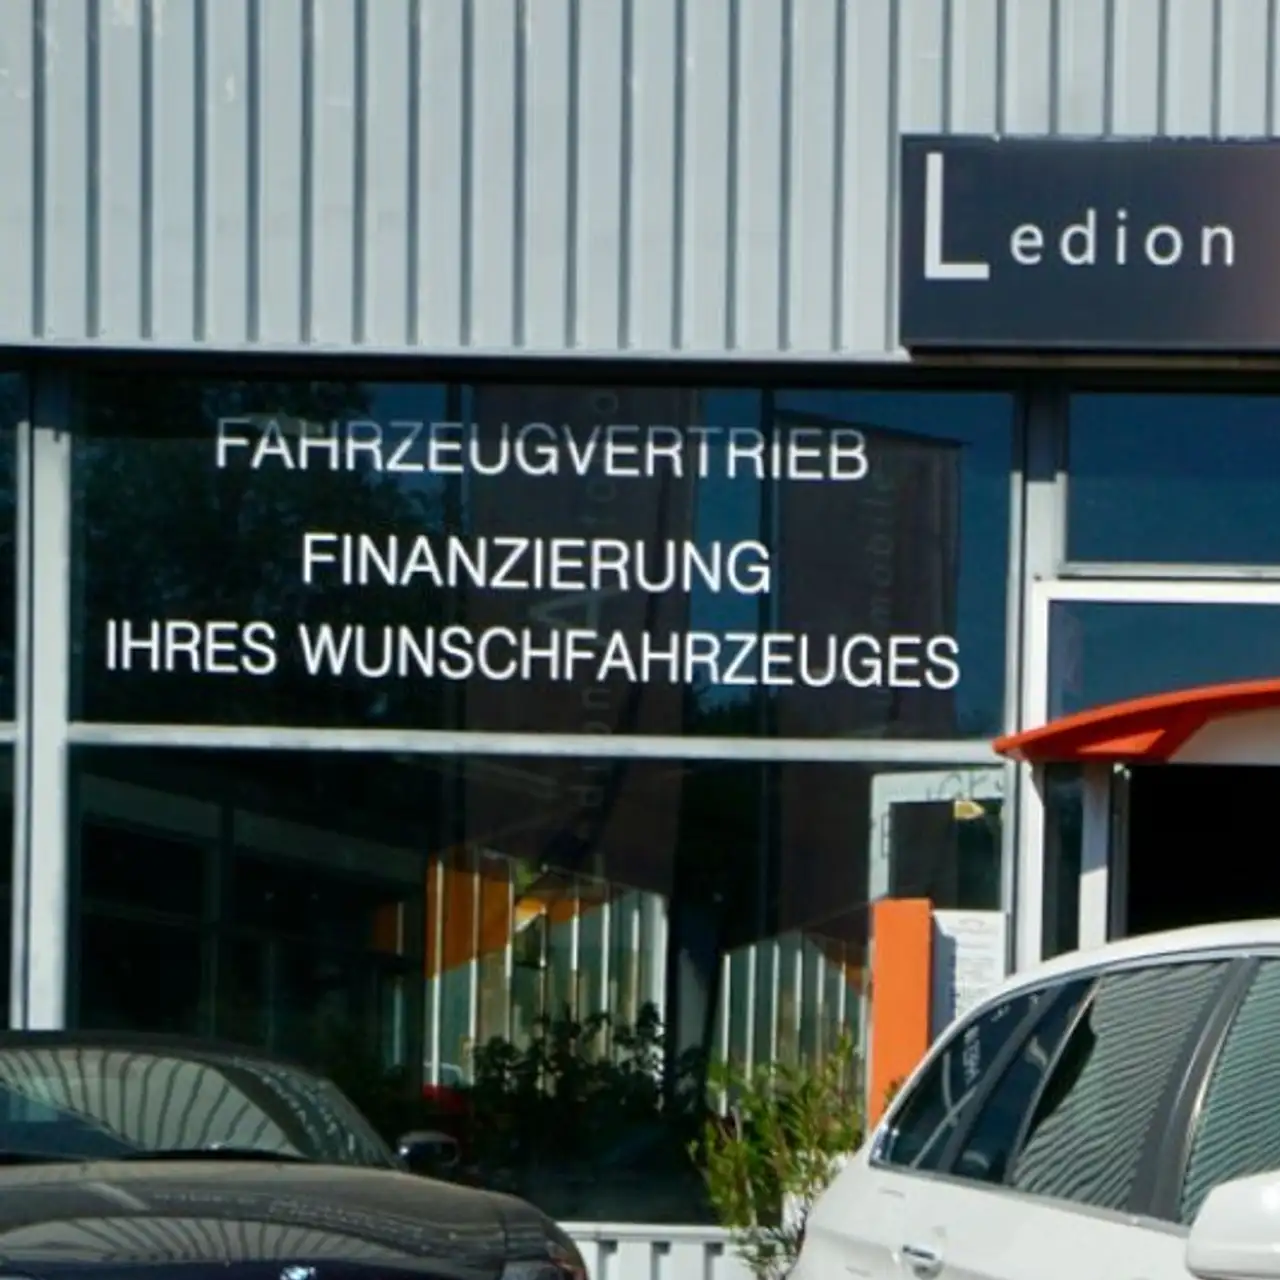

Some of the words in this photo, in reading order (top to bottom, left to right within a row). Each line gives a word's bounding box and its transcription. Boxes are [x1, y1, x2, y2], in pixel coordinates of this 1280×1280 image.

[923, 152, 1236, 280] Ledion
[214, 417, 869, 481] FAHRZEUGVERTRIEB
[303, 532, 771, 593] FINANZIERUNG
[107, 619, 277, 675] IHRES
[299, 623, 960, 689] WUNSCHFAHRZEUGES
